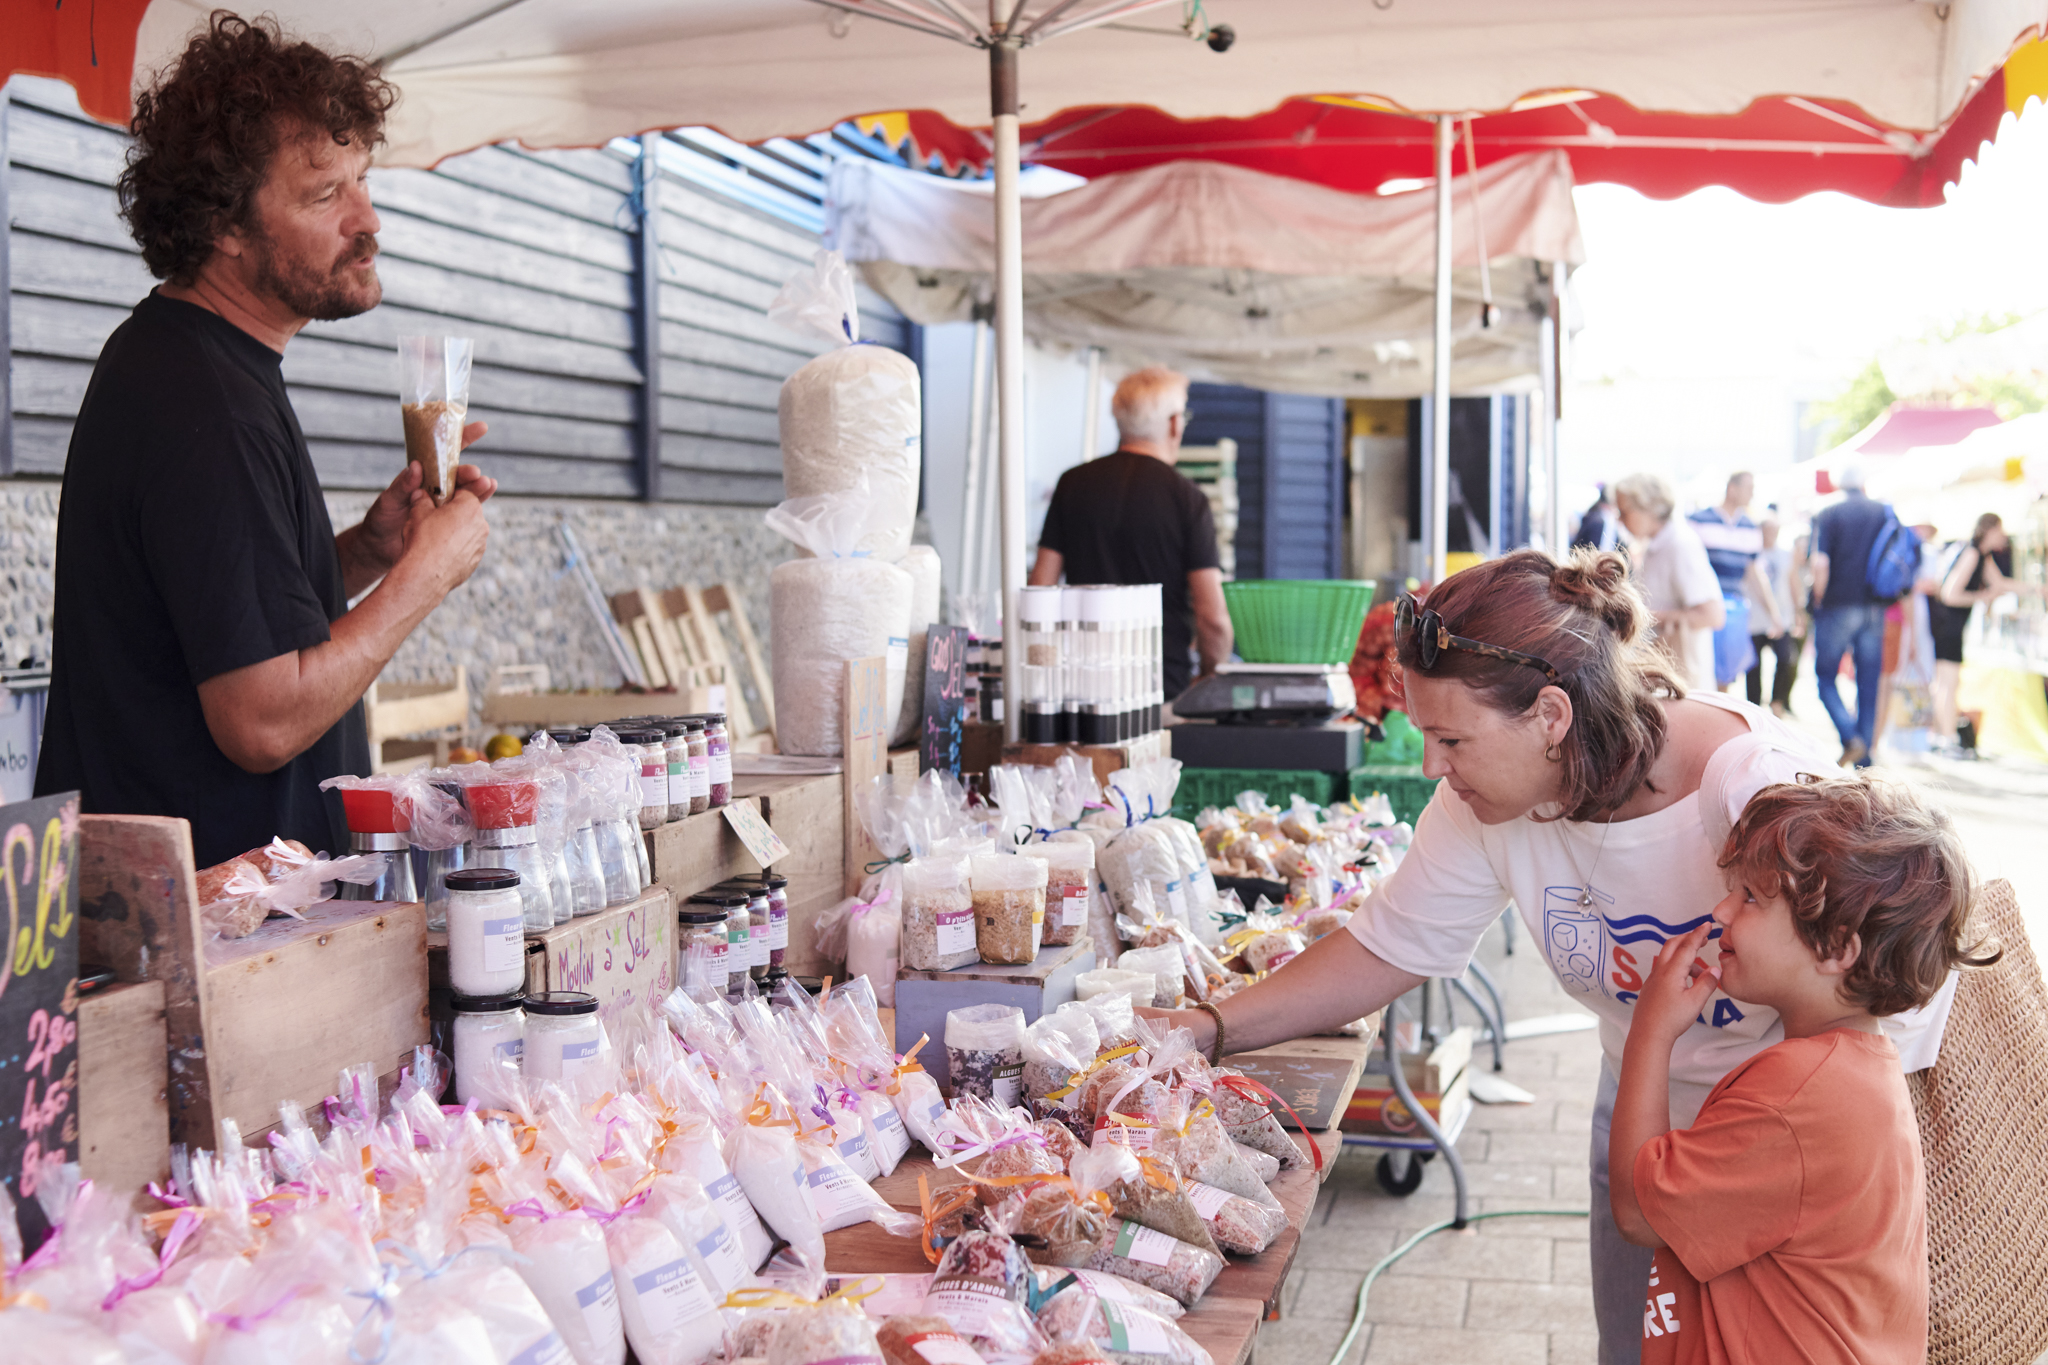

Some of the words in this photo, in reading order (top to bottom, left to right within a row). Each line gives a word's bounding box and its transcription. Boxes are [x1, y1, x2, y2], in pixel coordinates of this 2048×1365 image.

[503, 923, 519, 932] Fleur
[603, 929, 613, 972] à
[999, 1067, 1020, 1078] ALGUES
[818, 1171, 837, 1182] Fleur
[717, 1181, 733, 1195] Fleur
[825, 1181, 840, 1190] Vents
[656, 1269, 677, 1286] Fleur
[662, 1283, 679, 1294] Vents
[961, 1280, 1006, 1298] D'ARMOR
[964, 1294, 988, 1304] Marais
